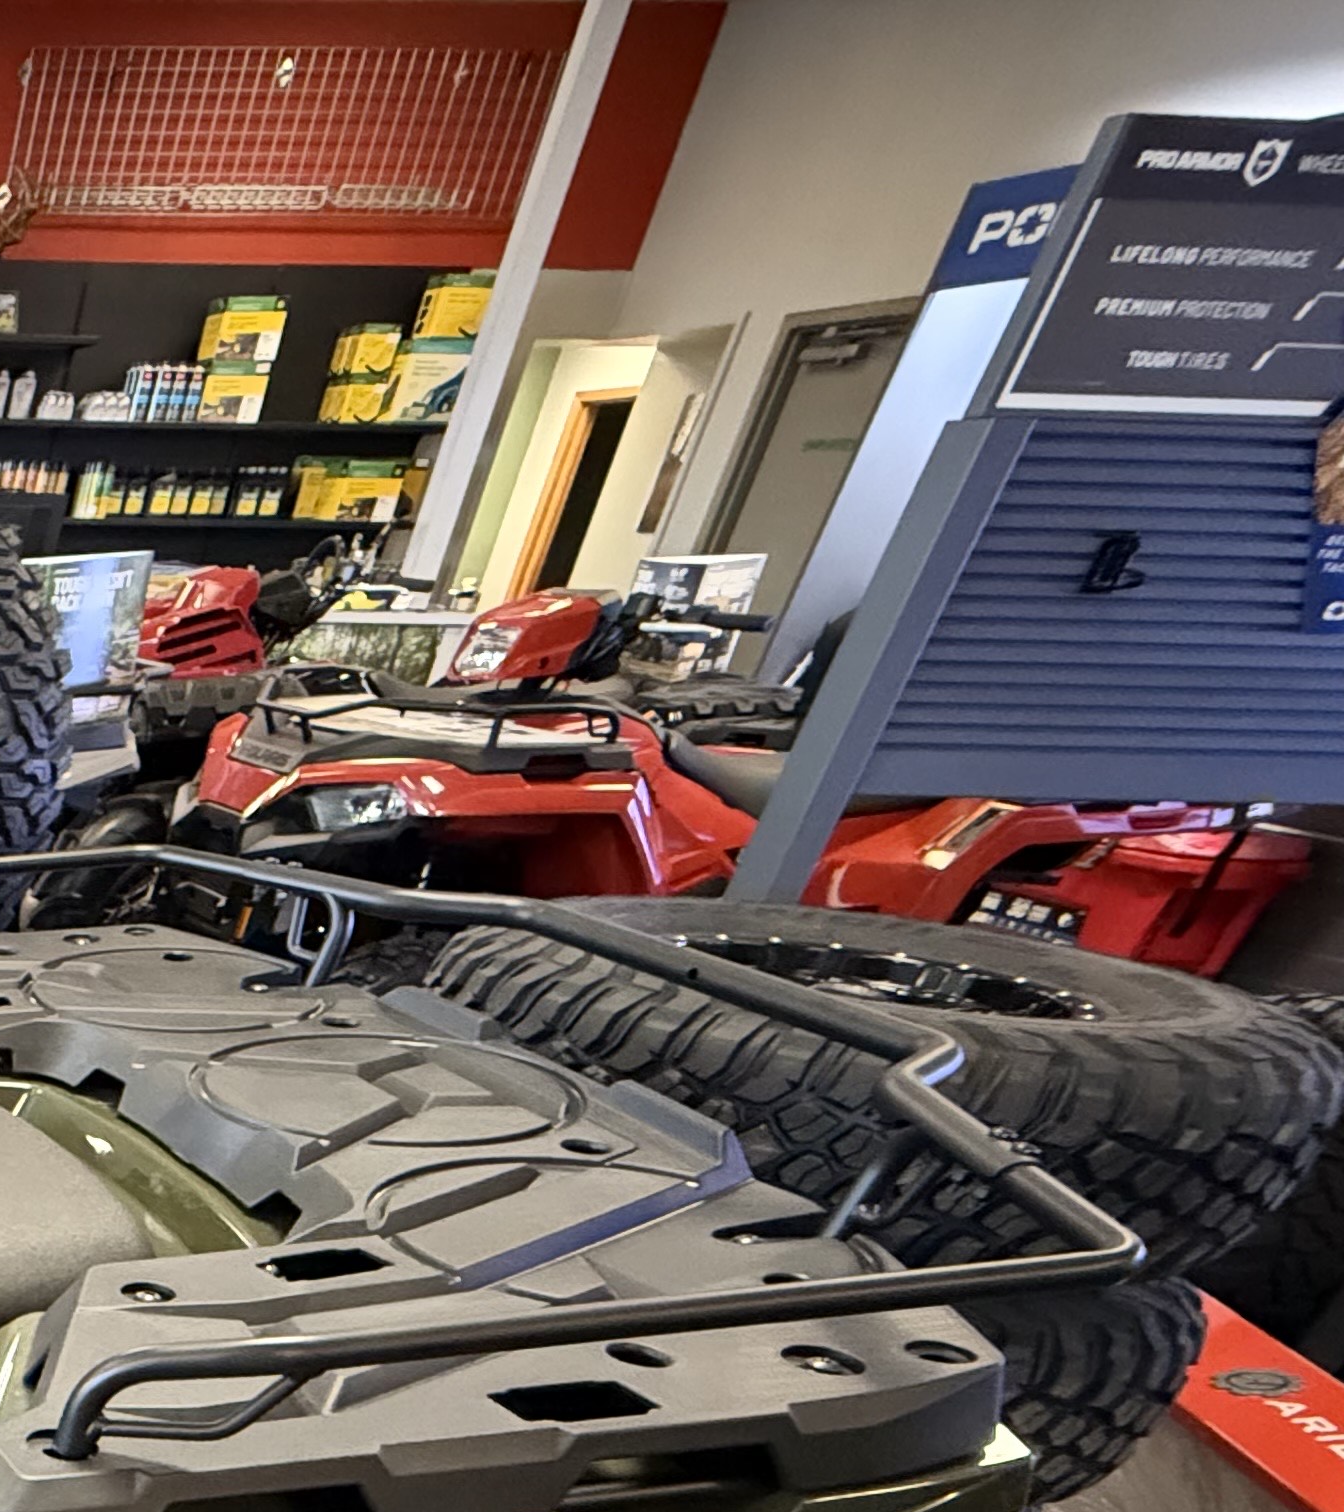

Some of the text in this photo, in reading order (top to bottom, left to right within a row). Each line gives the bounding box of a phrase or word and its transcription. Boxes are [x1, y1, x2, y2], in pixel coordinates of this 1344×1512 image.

[1110, 244, 1317, 269] LIFELONG PERFORMANCE
[1094, 297, 1275, 320] PREMIUM PROTECTION
[1126, 350, 1232, 371] TOUGH TIRES
